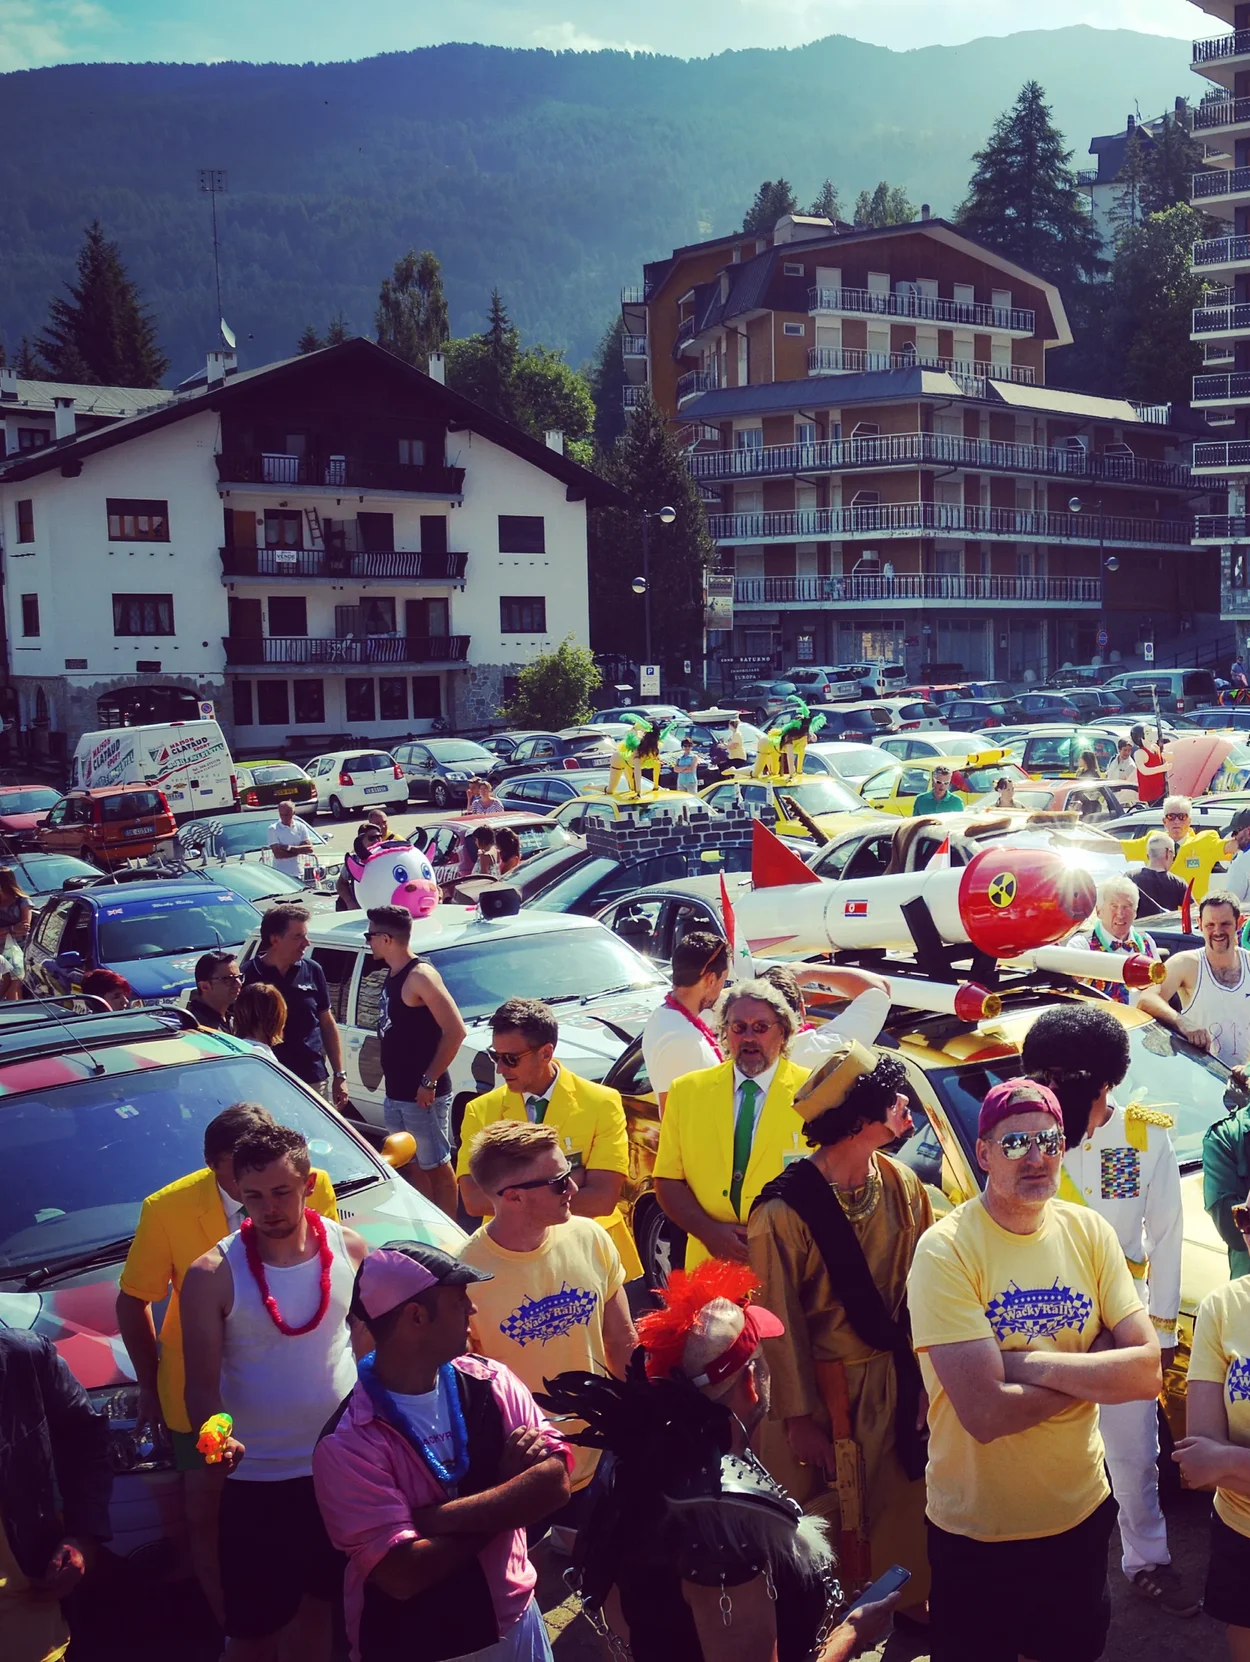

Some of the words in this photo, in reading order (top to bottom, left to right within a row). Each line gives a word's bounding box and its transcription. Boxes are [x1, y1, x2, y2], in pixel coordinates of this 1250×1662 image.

[169, 737, 195, 749] MAISON
[171, 737, 208, 755] CLATAUD
[522, 1311, 551, 1330] Wacky
[553, 1302, 584, 1317] Rally
[1003, 1305, 1040, 1321] Wacky
[1042, 1303, 1075, 1317] Rally
